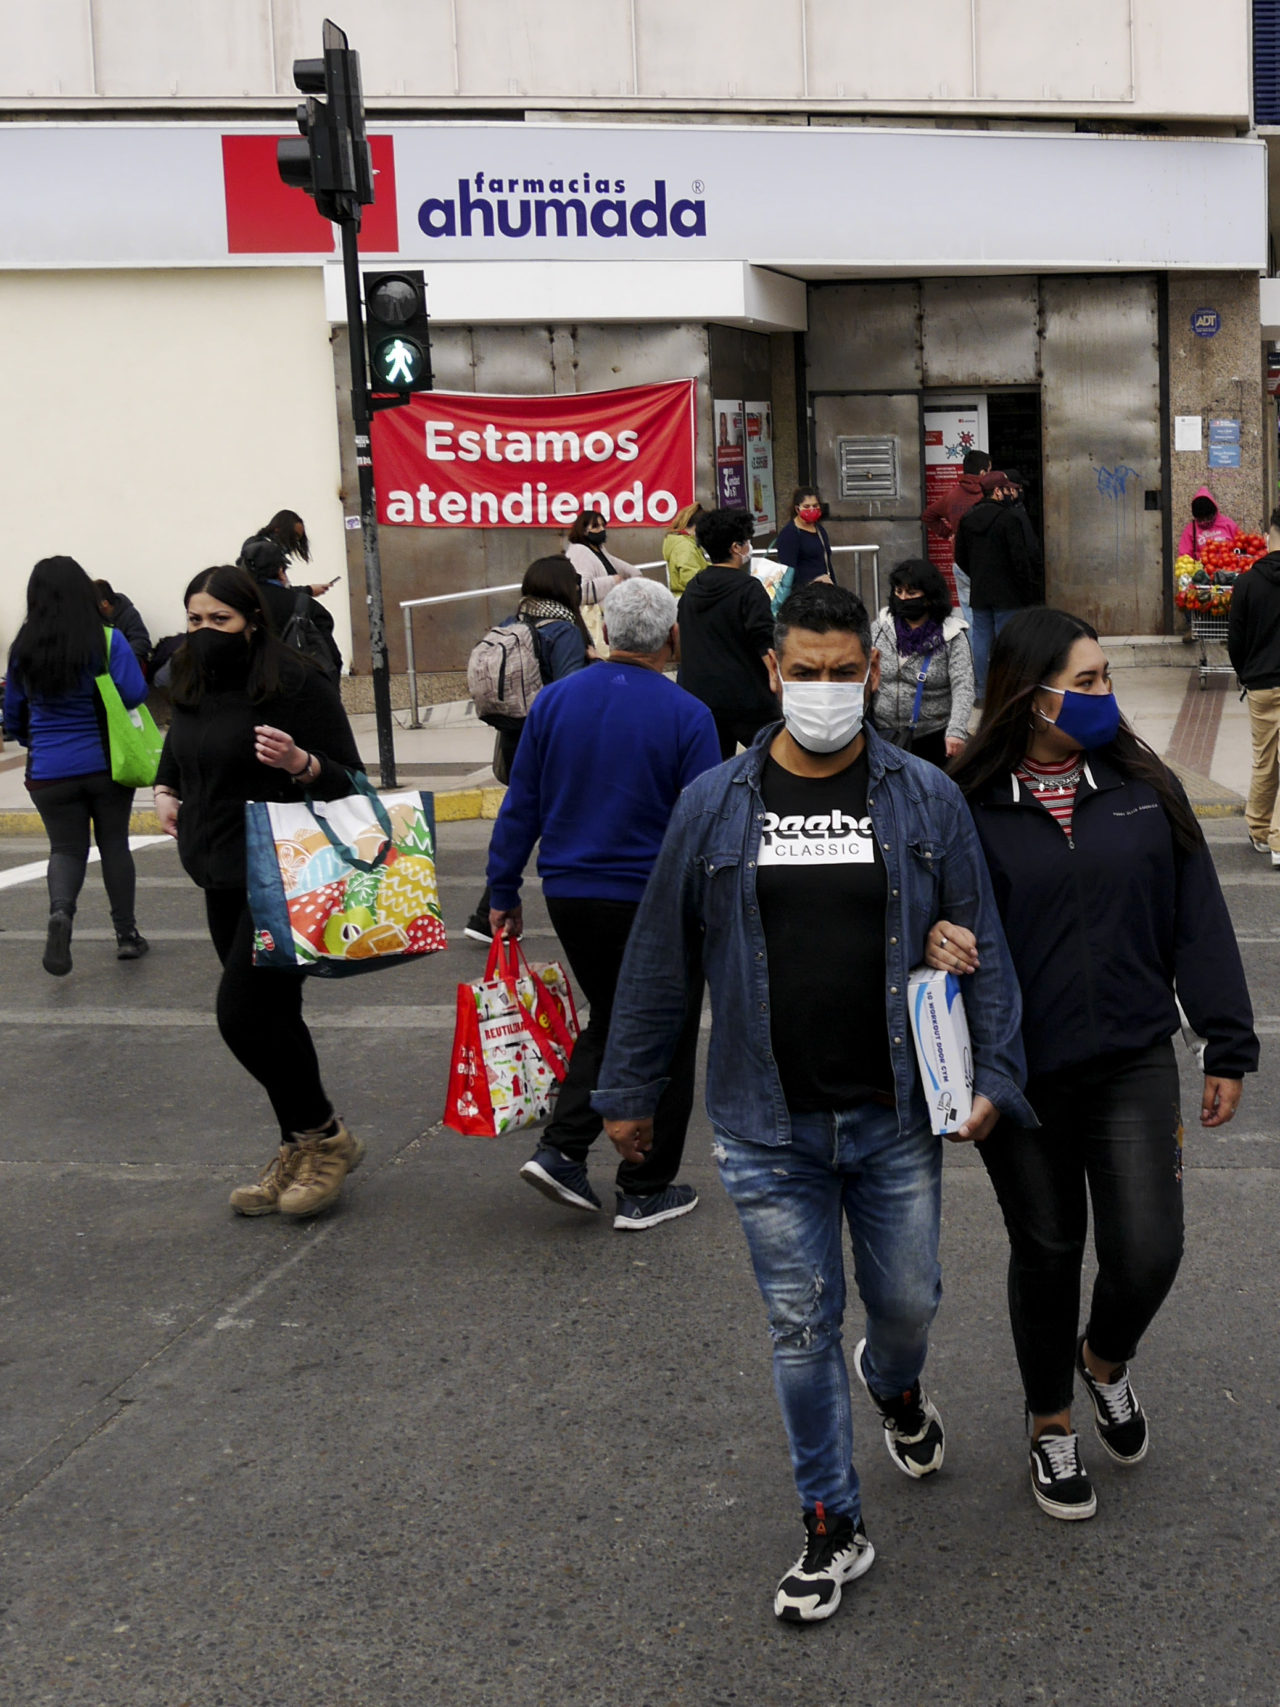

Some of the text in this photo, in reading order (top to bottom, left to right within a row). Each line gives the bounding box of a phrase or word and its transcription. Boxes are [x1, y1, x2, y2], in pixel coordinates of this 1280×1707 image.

[475, 172, 626, 195] farmacias
[417, 178, 707, 238] ahumada
[1195, 315, 1217, 327] ADT
[425, 421, 639, 463] Estamos
[386, 480, 678, 524] atendiendo
[762, 809, 873, 846] Reebo
[774, 842, 860, 857] CLASSIC
[929, 1002, 941, 1040] WORKOUT
[936, 1042, 946, 1063] DOOR
